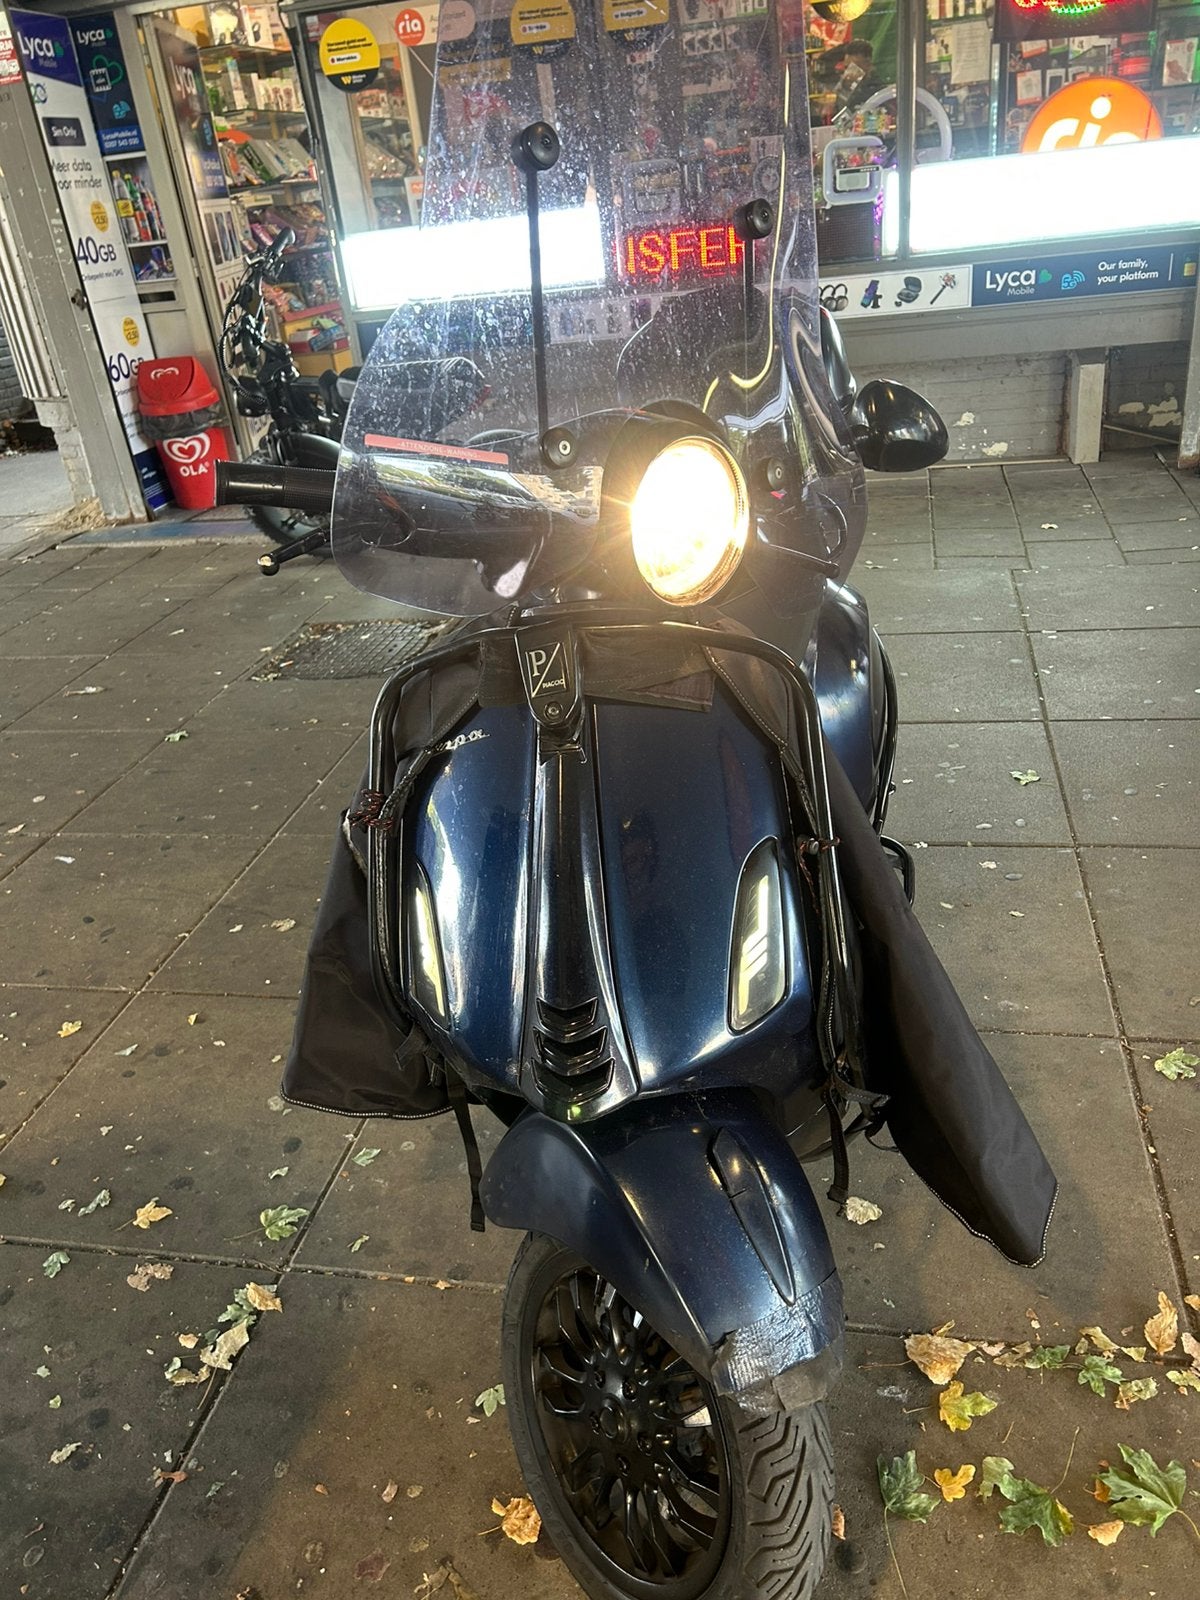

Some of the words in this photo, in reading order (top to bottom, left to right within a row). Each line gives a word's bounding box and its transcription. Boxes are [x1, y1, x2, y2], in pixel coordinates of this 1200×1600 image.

[398, 14, 422, 34] ria
[76, 29, 105, 45] Lyca
[17, 31, 55, 60] Lyca
[169, 56, 198, 99] Lyca
[51, 126, 62, 137] Sim
[72, 158, 92, 172] data
[56, 179, 71, 190] oor
[74, 175, 102, 189] minder
[77, 235, 118, 265] 40GB
[1097, 260, 1116, 272] Our
[1118, 258, 1148, 270] family,
[985, 269, 1036, 292] Lyca
[1097, 274, 1118, 285] your
[1120, 270, 1159, 284] platform
[1006, 286, 1036, 297] Mobile
[179, 463, 208, 477] OLA
[529, 649, 547, 677] P
